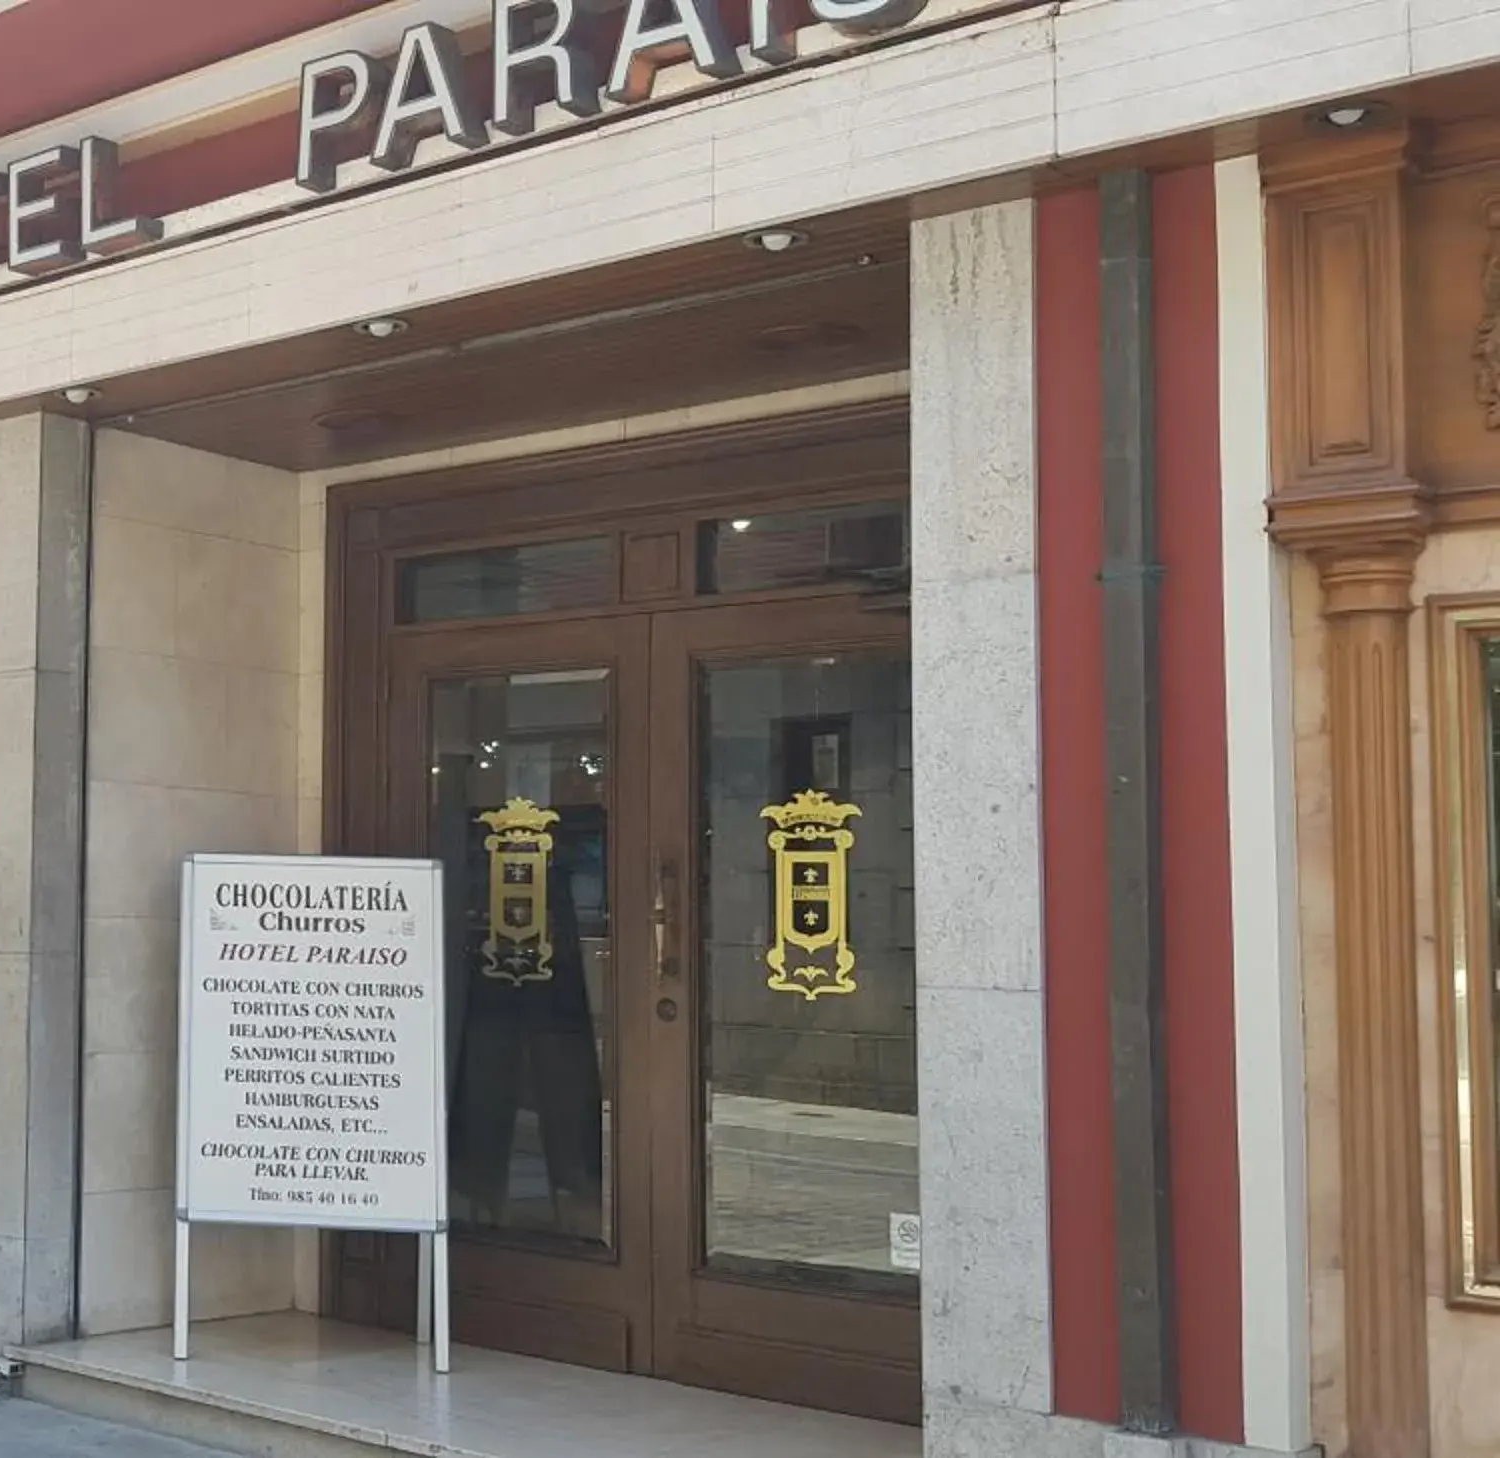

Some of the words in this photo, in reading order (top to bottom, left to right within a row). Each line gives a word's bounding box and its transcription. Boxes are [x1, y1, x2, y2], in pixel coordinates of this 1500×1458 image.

[215, 881, 408, 913] CHOCOLATERÍA
[258, 910, 366, 934] Churros
[219, 943, 299, 963] HOTEL
[305, 945, 408, 967] PARAISO
[202, 977, 301, 995] CHOCOLATE
[305, 981, 341, 997] CON
[344, 982, 424, 999] CHURROS
[231, 1001, 310, 1017] TORTITAS
[314, 1003, 349, 1019] CON
[353, 1004, 396, 1021] NATA
[229, 1022, 397, 1043] HELADO-PEÑASANTA
[230, 1045, 317, 1063] SANDWICH
[321, 1049, 395, 1066] SURTIDO
[224, 1068, 306, 1085] PERRITOS
[310, 1071, 401, 1089] CALIENTES
[245, 1091, 380, 1111] HAMBURGUESAS
[235, 1113, 335, 1134] ENSALADAS,
[200, 1143, 301, 1161] CHOCOLATE
[306, 1146, 341, 1162] CON
[345, 1149, 427, 1167] CHURROS
[254, 1162, 297, 1179] PARA
[301, 1165, 369, 1182] LLEVAR.
[287, 1191, 313, 1204] 985
[318, 1191, 335, 1204] 40
[341, 1192, 357, 1205] 16
[361, 1193, 379, 1205] 40
